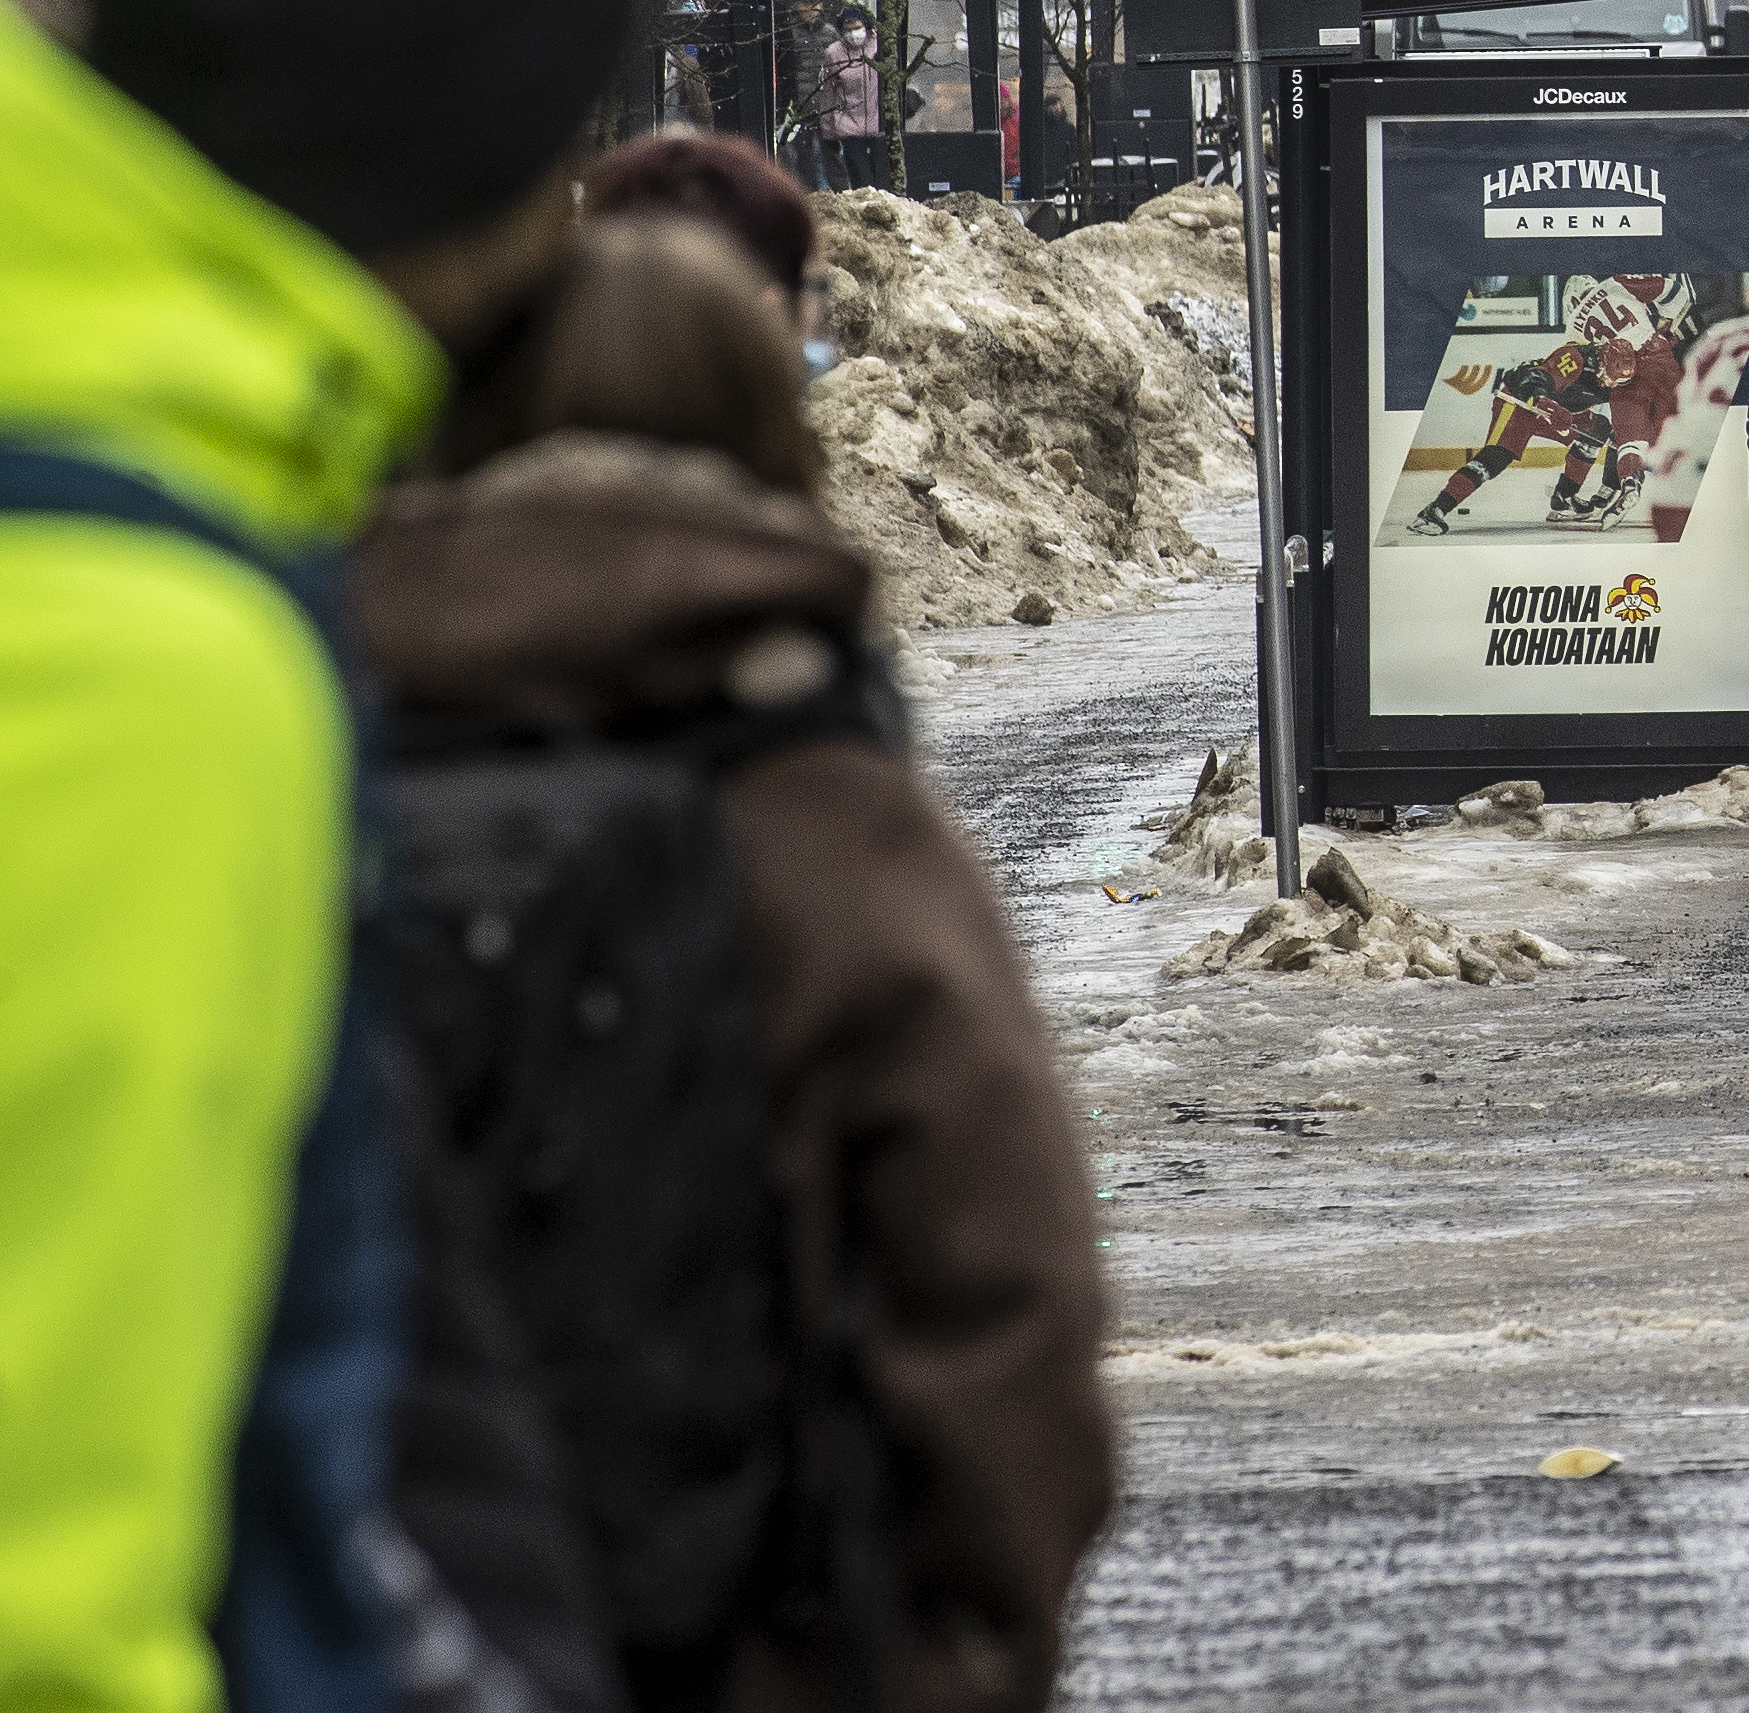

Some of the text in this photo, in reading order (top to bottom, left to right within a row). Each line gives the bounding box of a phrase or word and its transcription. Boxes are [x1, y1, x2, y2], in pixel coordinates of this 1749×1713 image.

[1291, 69, 1304, 119] 529
[1533, 88, 1627, 105] JCDecaux
[1482, 159, 1667, 206] HARTWALL
[1516, 215, 1631, 230] ARENA
[1485, 585, 1602, 624] KOTONA
[1485, 626, 1662, 666] KOHDATAAN
